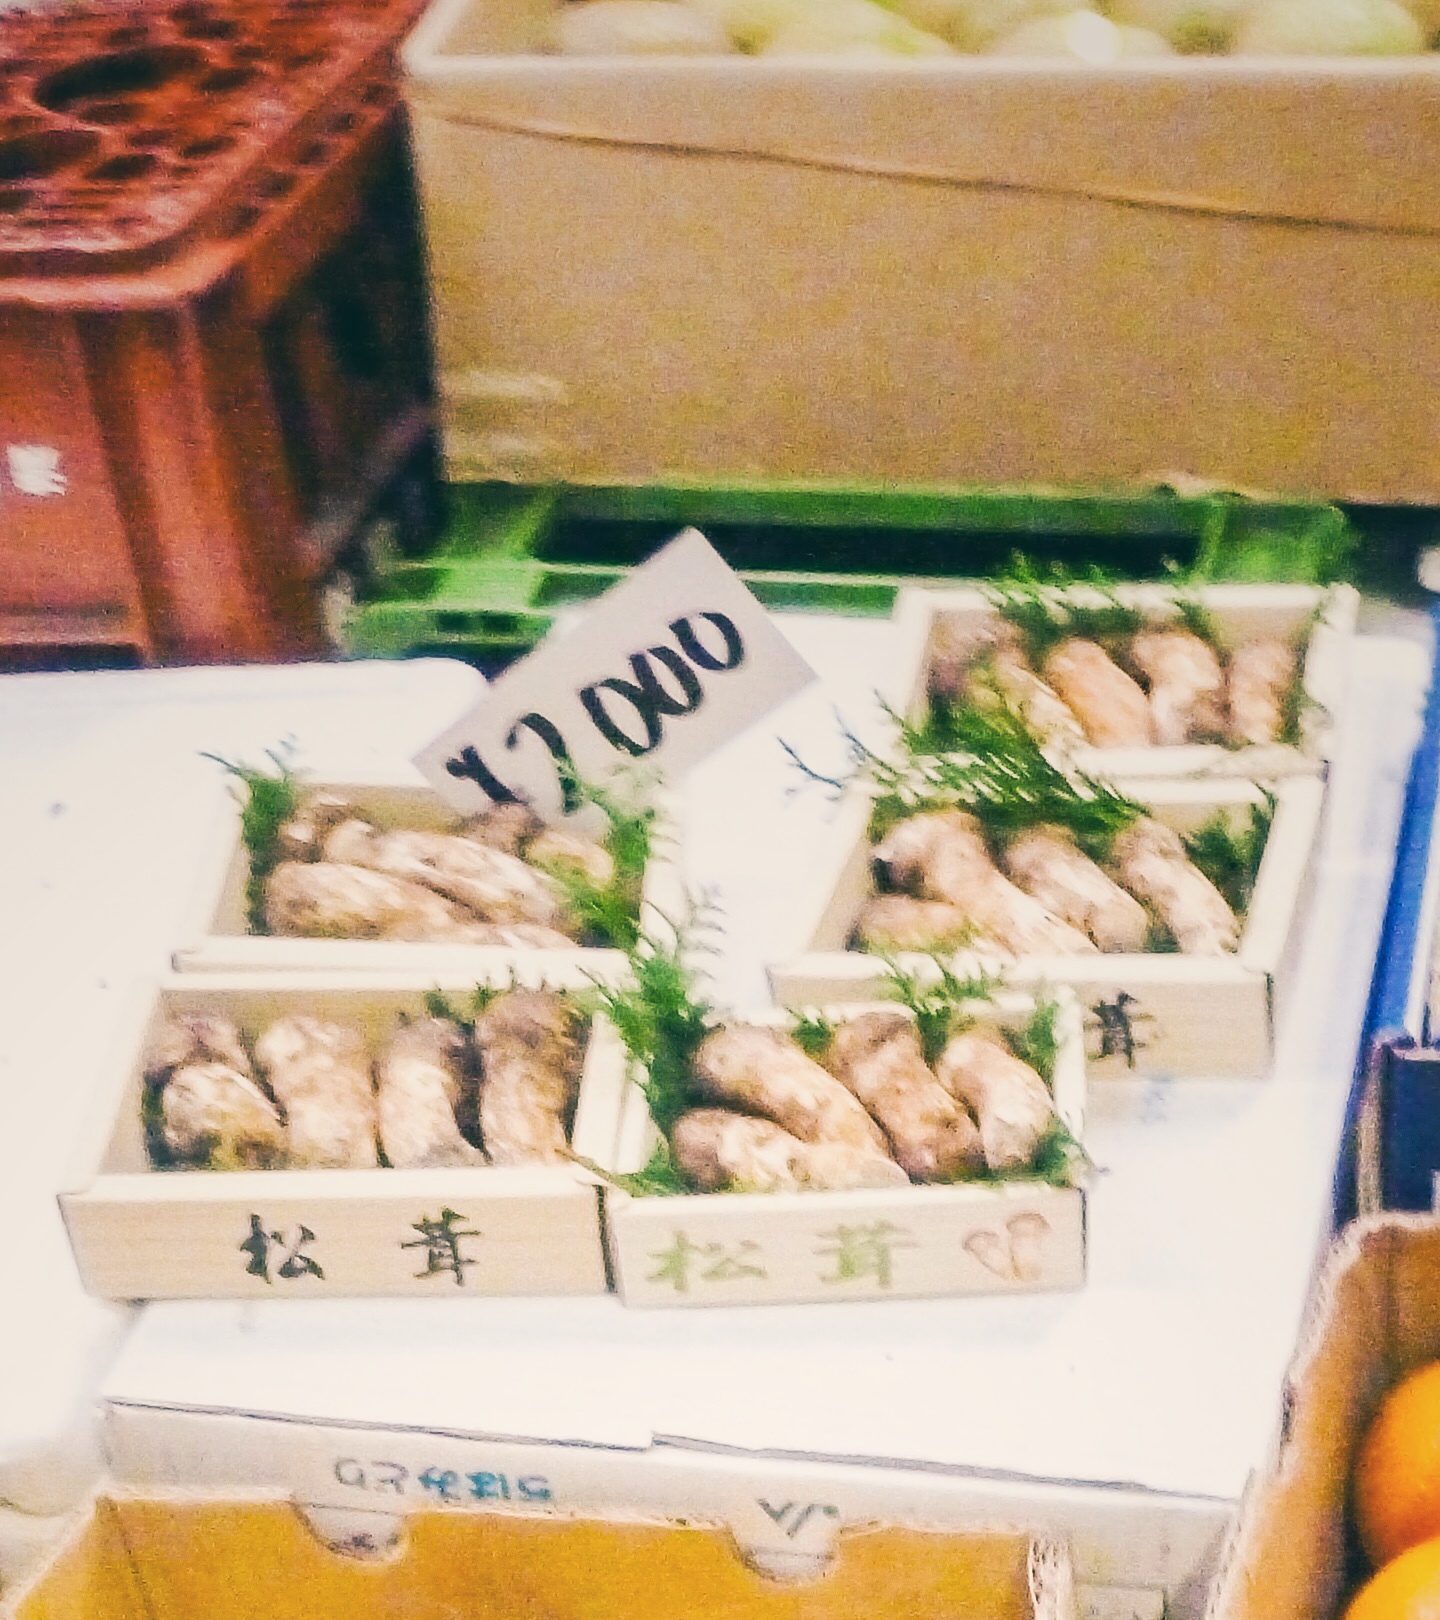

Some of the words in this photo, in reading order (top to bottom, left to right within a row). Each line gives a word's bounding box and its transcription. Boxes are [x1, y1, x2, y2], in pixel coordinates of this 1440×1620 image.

[1083, 989, 1158, 1069] 茸
[239, 1205, 482, 1287] 松茸
[646, 1215, 922, 1293] 松茸
